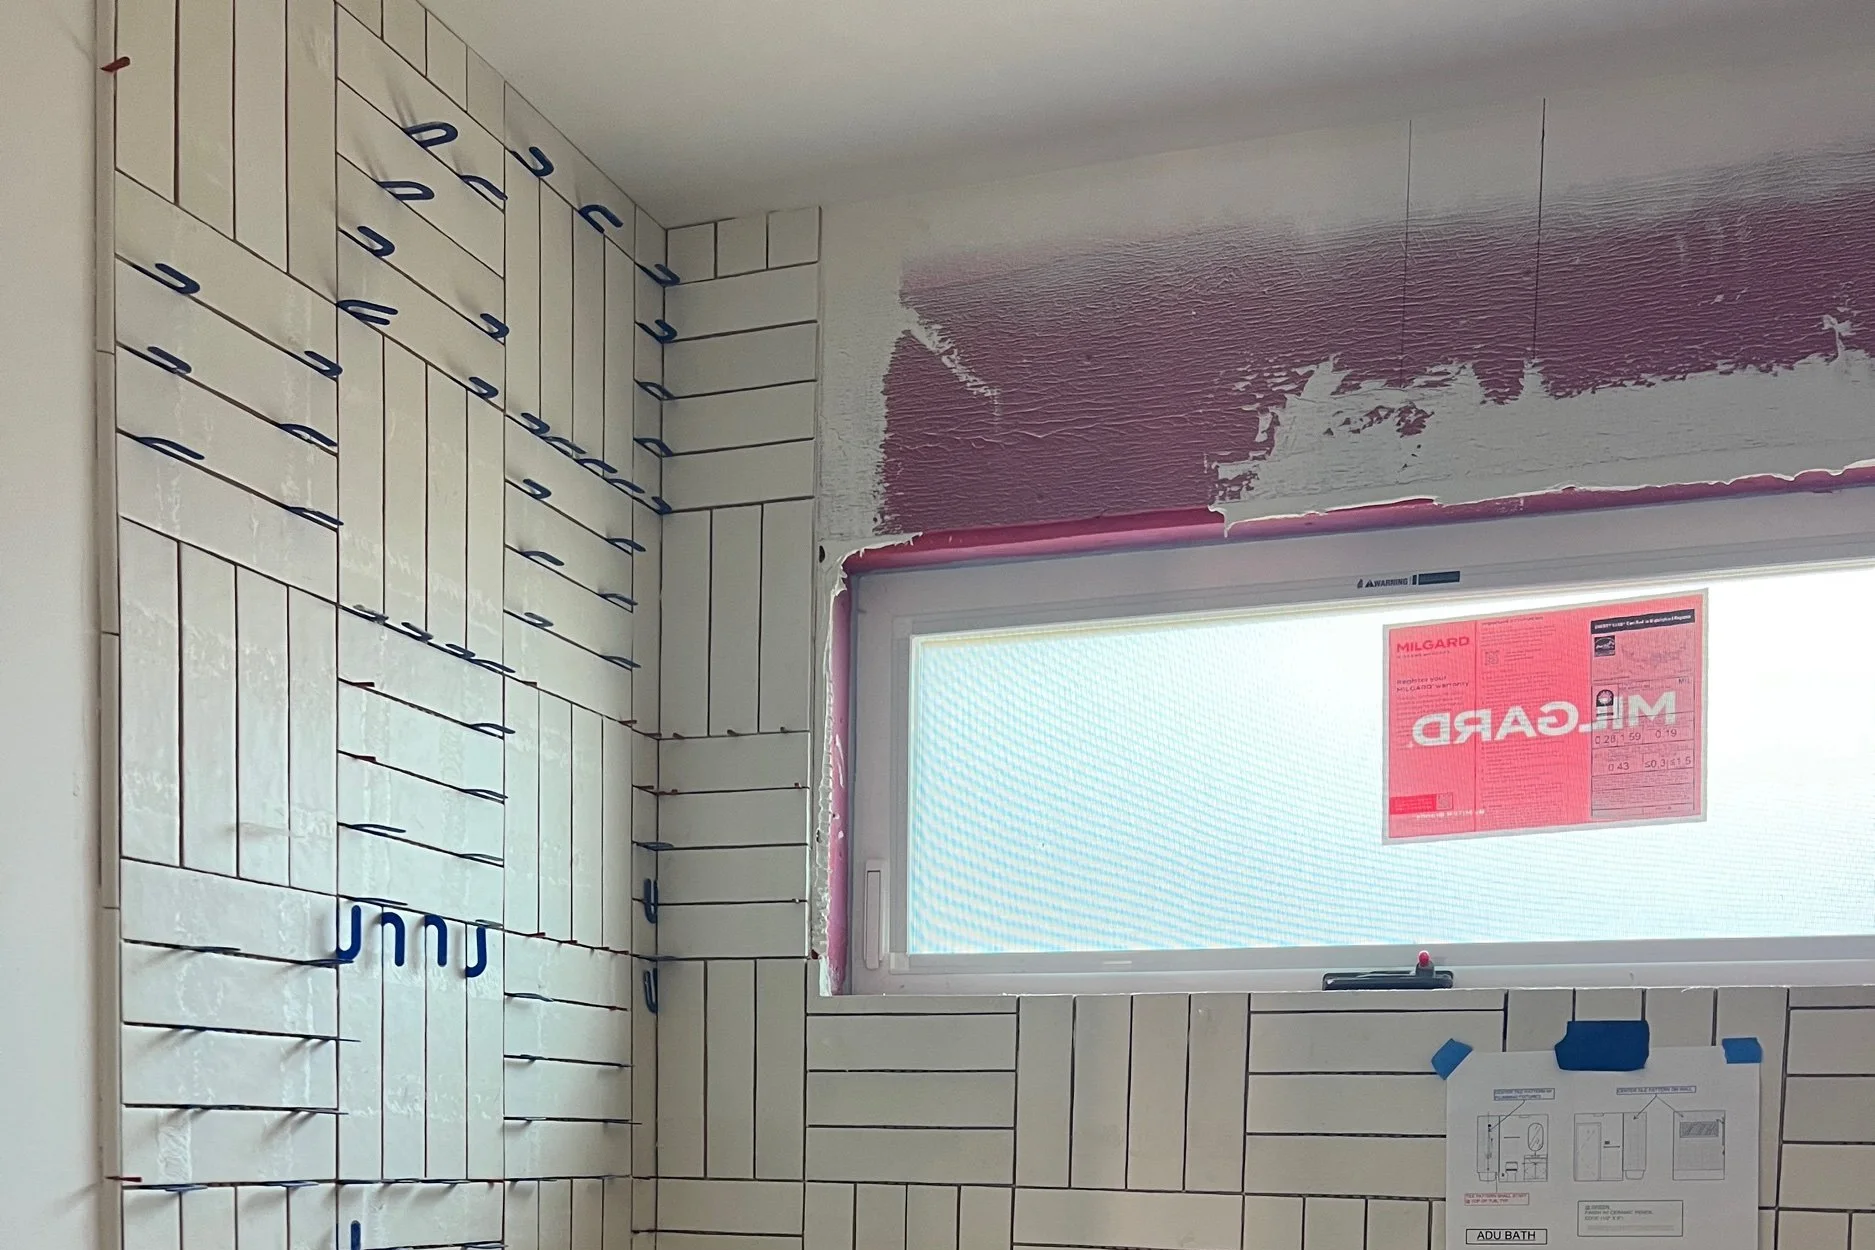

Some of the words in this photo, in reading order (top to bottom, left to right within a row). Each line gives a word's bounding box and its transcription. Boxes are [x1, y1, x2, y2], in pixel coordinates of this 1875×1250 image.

[1374, 577, 1408, 587] WARNING
[1396, 636, 1470, 653] MILGARD
[1477, 1230, 1502, 1241] ADU
[1504, 1230, 1536, 1241] BATH
